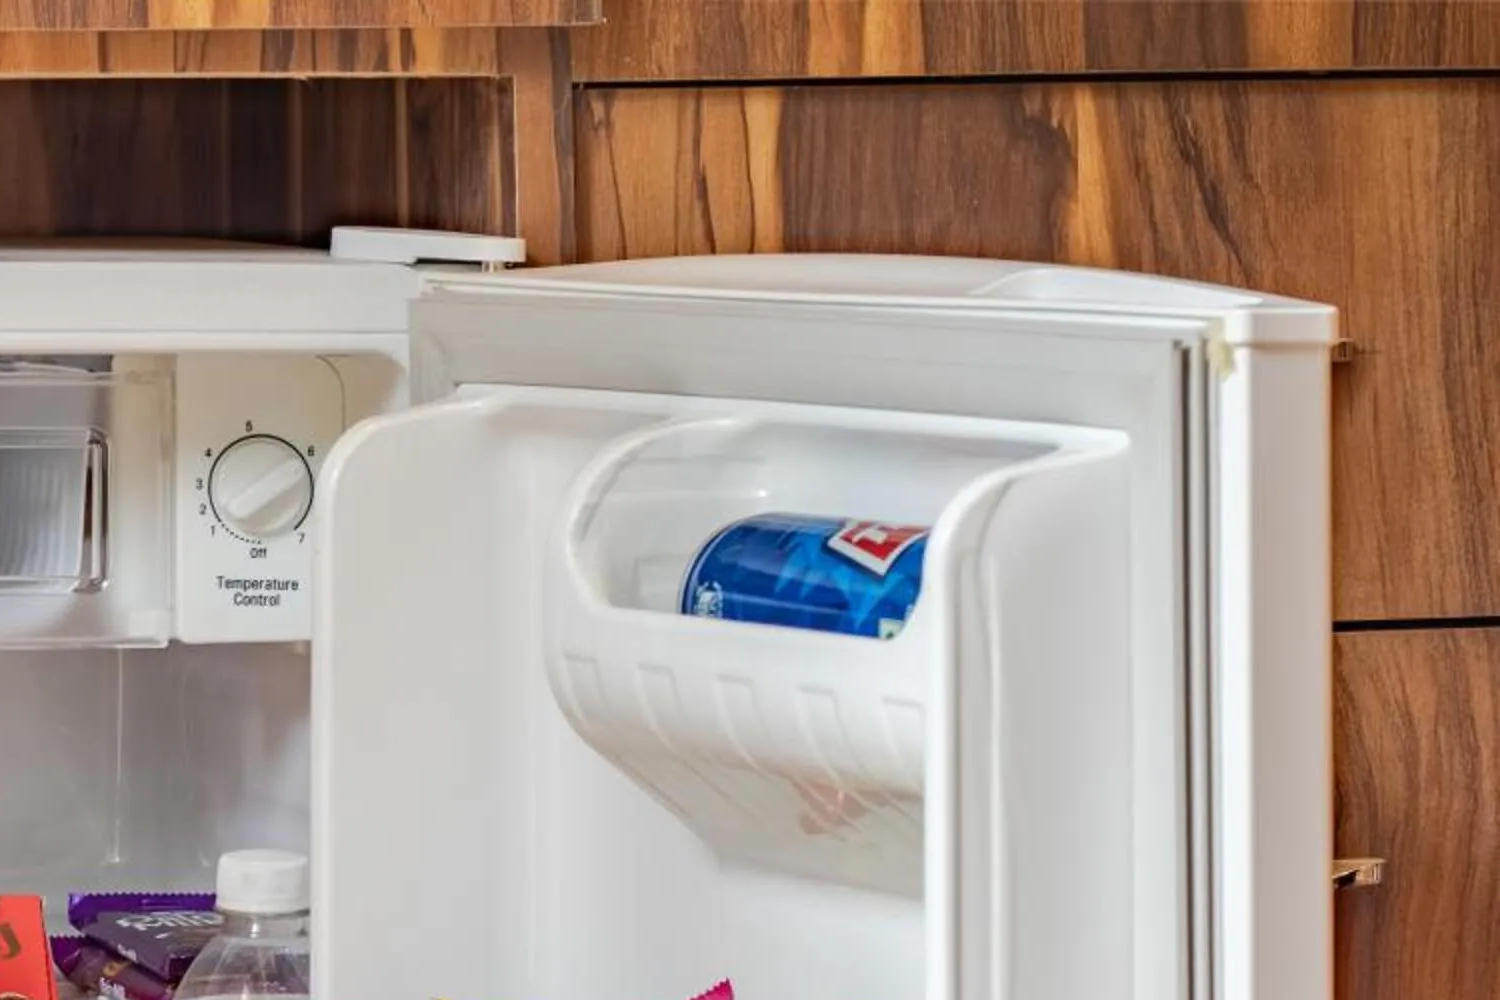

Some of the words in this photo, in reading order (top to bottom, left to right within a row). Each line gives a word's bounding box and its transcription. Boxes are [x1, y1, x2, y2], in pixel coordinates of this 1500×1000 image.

[250, 547, 267, 558] Off
[216, 576, 299, 592] Temperature
[233, 593, 281, 606] Control
